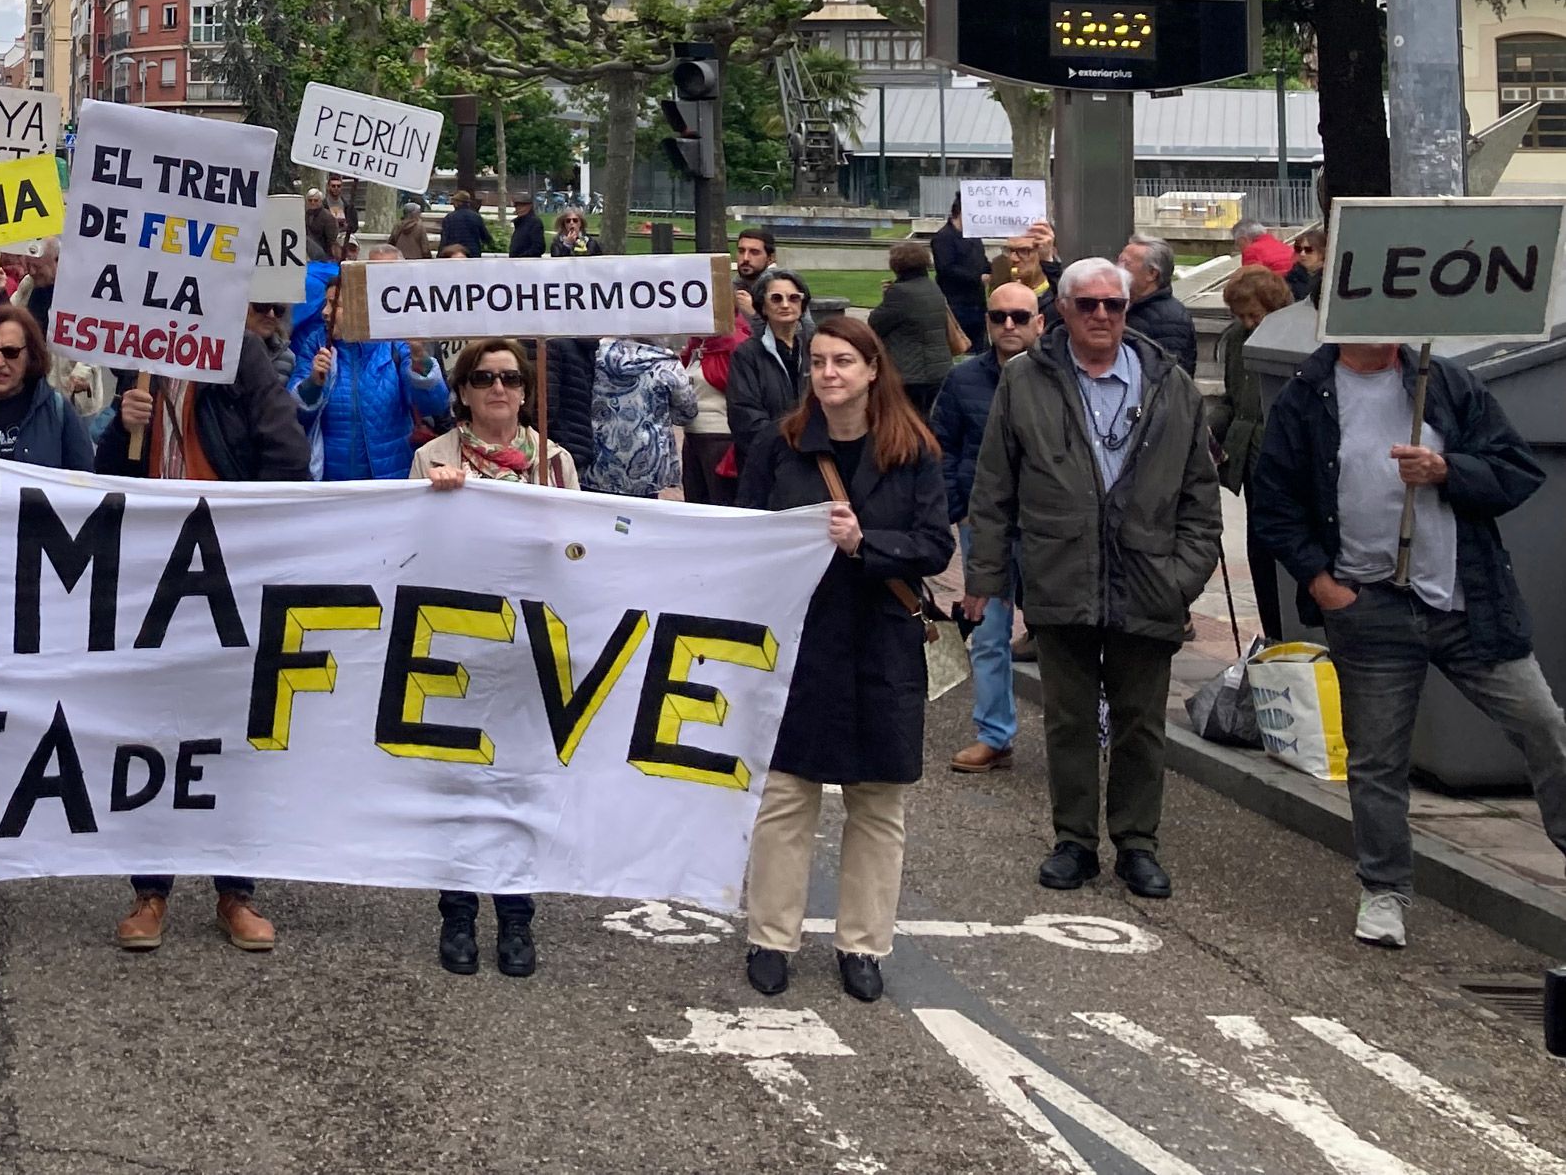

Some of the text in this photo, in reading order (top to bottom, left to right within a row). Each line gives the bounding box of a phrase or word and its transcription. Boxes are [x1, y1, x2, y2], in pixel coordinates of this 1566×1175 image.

[1078, 68, 1133, 79] exteriorplus
[313, 143, 330, 160] DE
[314, 105, 431, 163] PEDRÚN
[92, 144, 260, 208] EL TREN
[967, 185, 1009, 196] BASTA
[79, 203, 240, 263] DE FEVE
[91, 264, 204, 316] A LA
[381, 280, 709, 314] CAMPOHERMOSO
[1337, 239, 1539, 300] LEÓN
[110, 737, 222, 813] DE
[246, 584, 780, 792] FEVE
